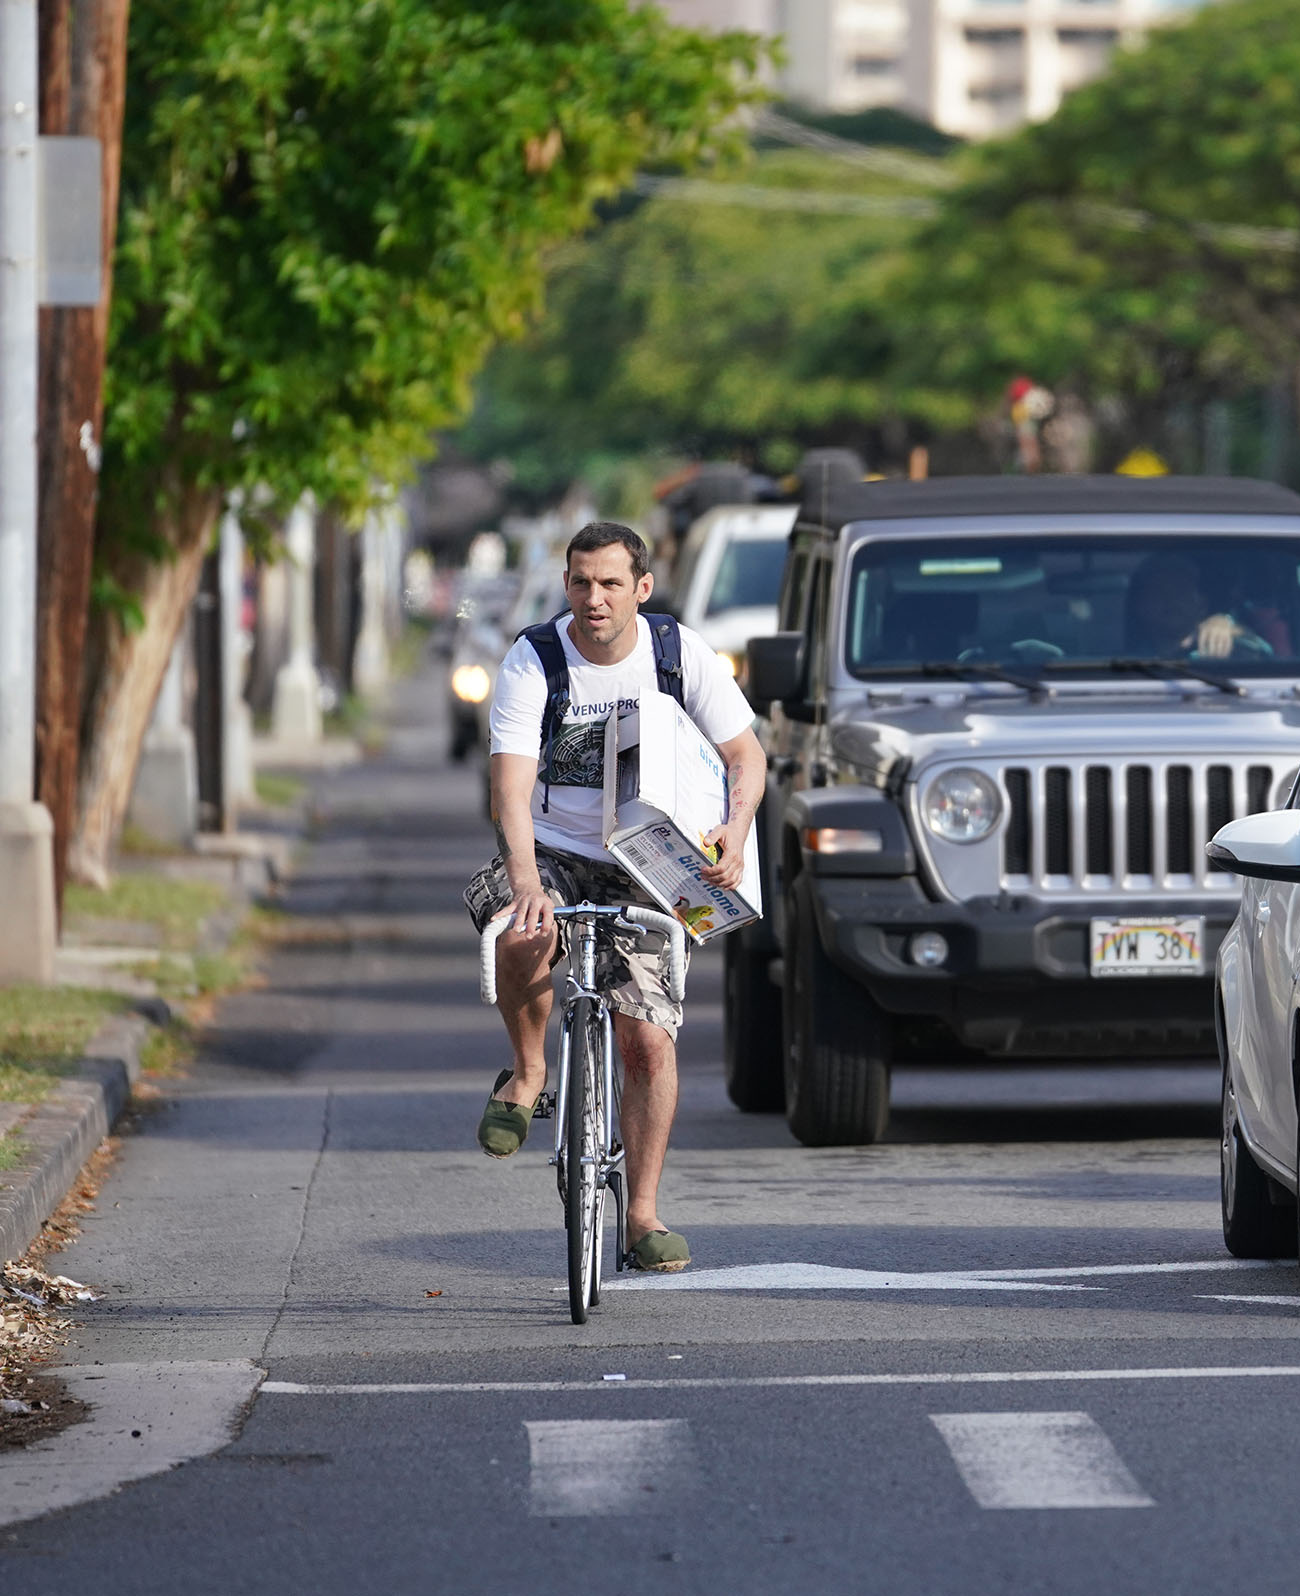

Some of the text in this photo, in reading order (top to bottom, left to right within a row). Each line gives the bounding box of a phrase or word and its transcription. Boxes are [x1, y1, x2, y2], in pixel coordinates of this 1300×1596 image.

[571, 701, 614, 717] VENUS
[699, 743, 719, 777] bird
[1155, 931, 1196, 960] 387
